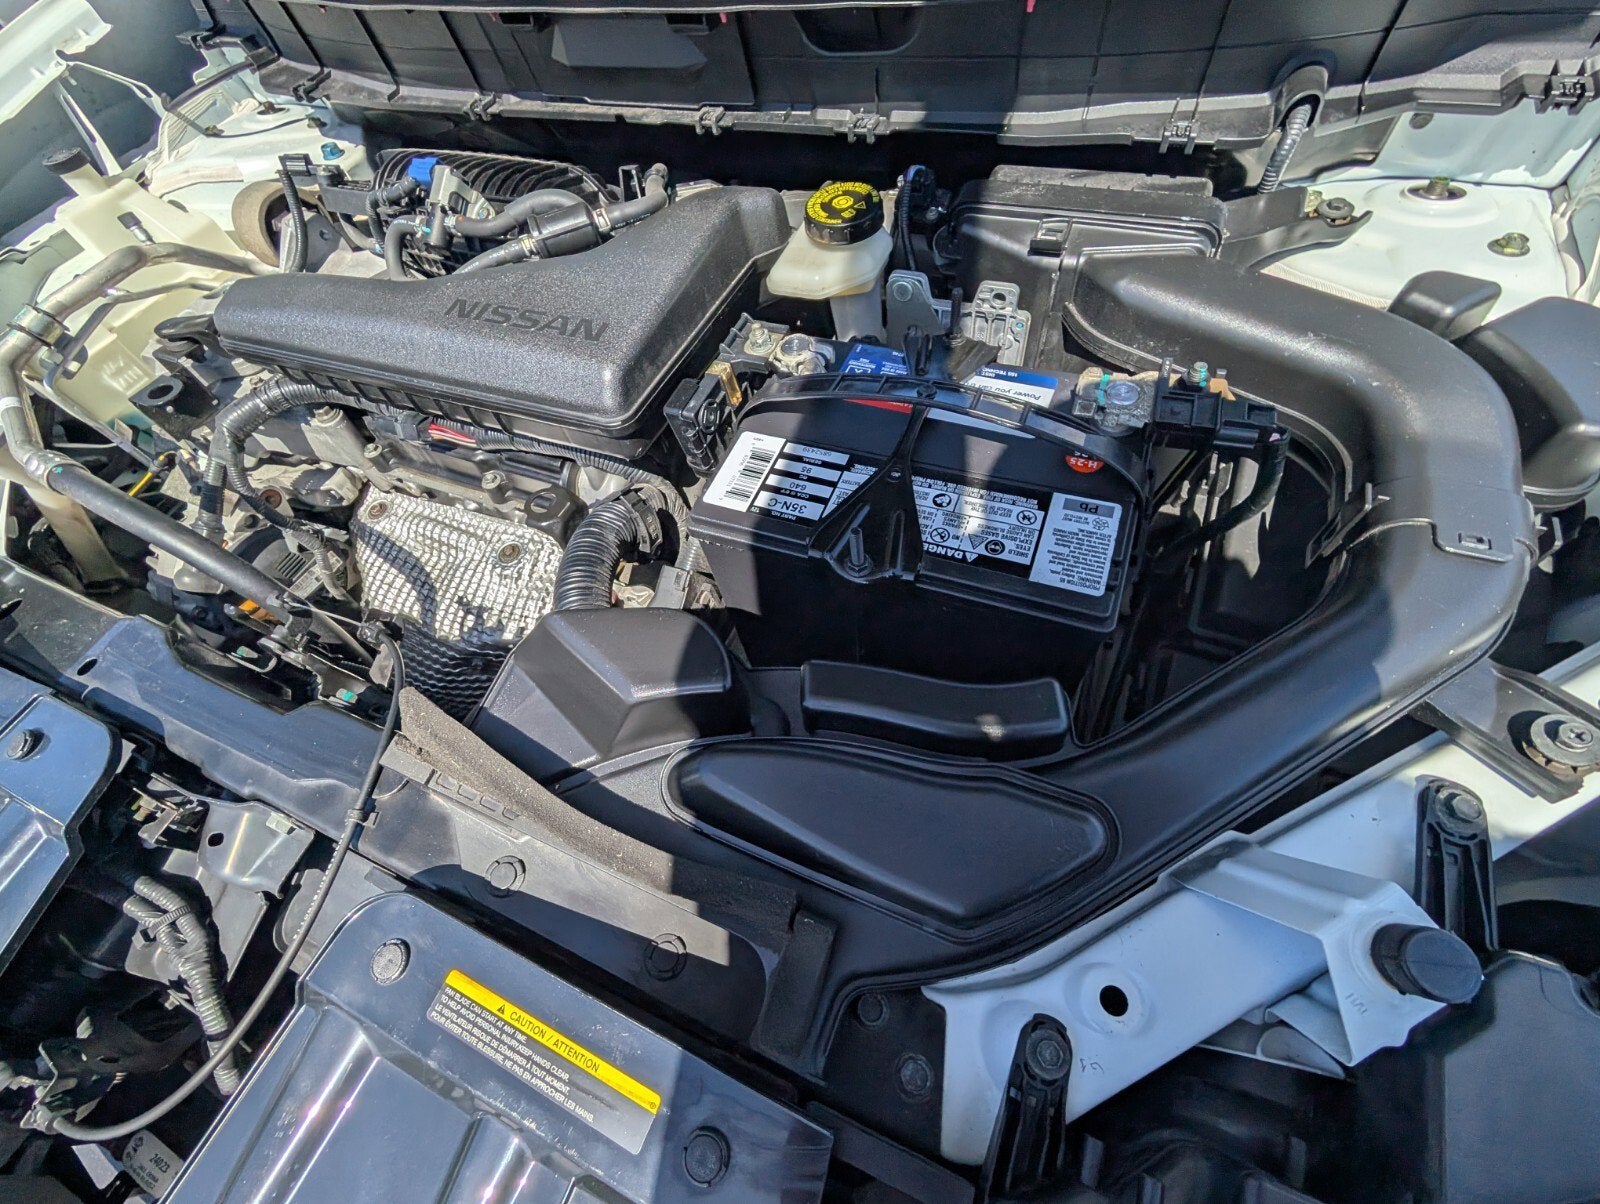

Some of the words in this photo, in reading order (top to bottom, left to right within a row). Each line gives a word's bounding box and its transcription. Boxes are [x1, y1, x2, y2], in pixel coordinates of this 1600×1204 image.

[445, 299, 610, 342] NISSAN
[994, 385, 1011, 394] you
[1012, 390, 1040, 400] Power
[801, 456, 822, 464] SERIAL
[799, 465, 812, 474] 95
[788, 481, 807, 491] 640
[766, 496, 807, 515] 35N-C
[1078, 501, 1099, 514] Pb
[780, 512, 796, 520] PART
[980, 528, 999, 538] GASES
[1000, 532, 1033, 546] EXPLOSIVE
[921, 542, 963, 558] DANGE
[1007, 548, 1029, 558] SHIELD
[1066, 578, 1100, 591] PROPOSITION
[443, 986, 456, 998] FAN
[453, 992, 471, 1008] BLADE
[469, 1002, 482, 1015] CAN
[480, 1009, 498, 1024] START
[495, 1018, 504, 1028] AT
[502, 1022, 515, 1035] ANY
[513, 1030, 528, 1044] TIME.
[439, 994, 449, 1004] TO
[447, 998, 461, 1012] HELP
[459, 1006, 476, 1021] AVOID
[474, 1016, 502, 1038] PERSONAL
[530, 1052, 552, 1070] HANDS
[549, 1064, 570, 1082] CLEAR.
[508, 1010, 546, 1040] CAUTION
[545, 1033, 552, 1043] /
[552, 1036, 600, 1073] ATTENTION
[434, 1002, 443, 1012] LE
[440, 1006, 473, 1031] VENTILATEUR
[471, 1026, 492, 1044] RISQUE
[490, 1038, 500, 1049] DE
[497, 1042, 528, 1067] DÉMARRER
[529, 1064, 546, 1079] TOUT
[543, 1073, 571, 1095] MOMENT.
[429, 1009, 446, 1025] POUR
[443, 1017, 463, 1036] ÉVITER
[460, 1029, 478, 1046] TOUTE
[475, 1040, 505, 1064] BLESSURE,
[503, 1058, 513, 1069] NE
[511, 1063, 524, 1076] PAS
[522, 1070, 533, 1082] EN
[529, 1075, 565, 1103] APPROCHER
[563, 1096, 576, 1110] LES
[573, 1104, 596, 1123] MAINS.
[149, 1153, 171, 1174] 24023
